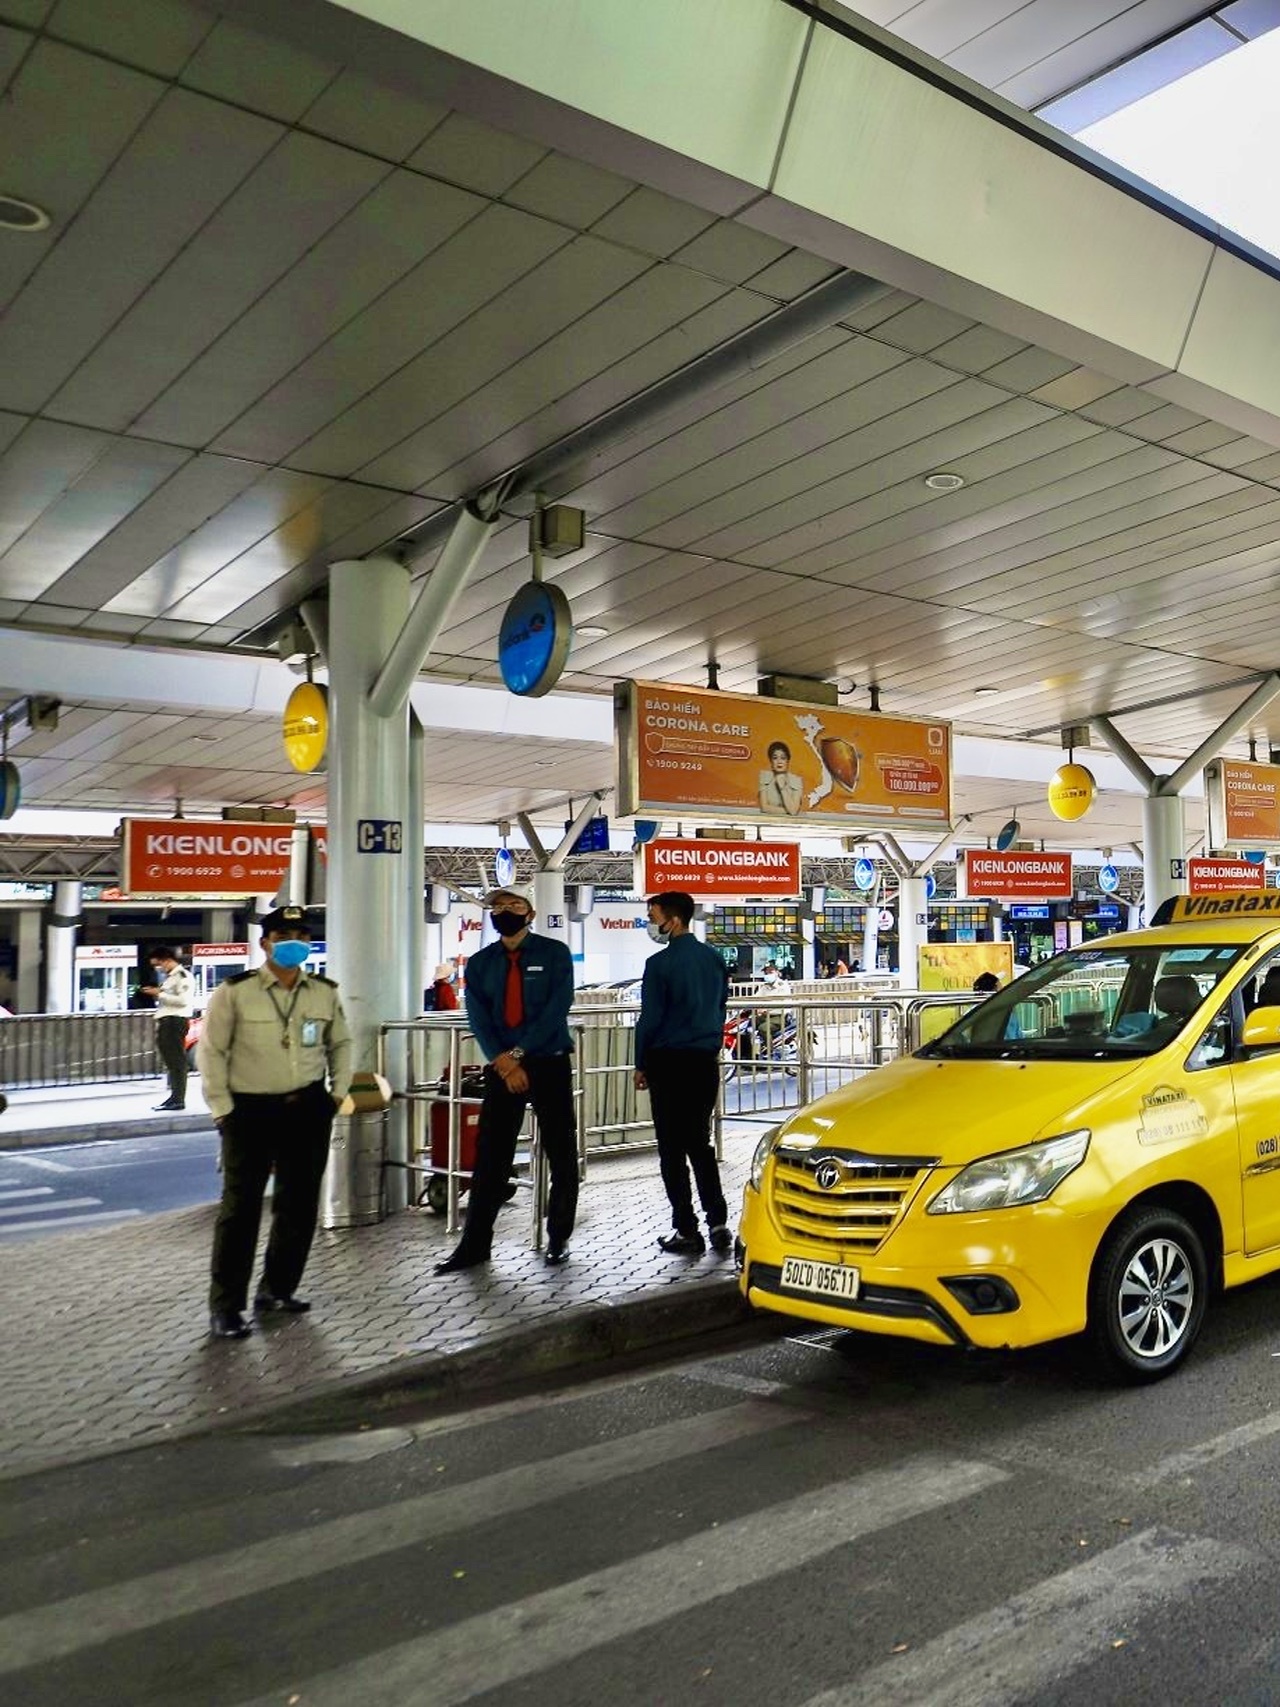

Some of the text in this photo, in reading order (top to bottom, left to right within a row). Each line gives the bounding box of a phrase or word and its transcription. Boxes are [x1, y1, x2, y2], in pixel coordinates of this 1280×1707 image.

[646, 714, 750, 737] CORONA CARE
[656, 759, 679, 770] 1900
[359, 822, 401, 851] C-13
[654, 849, 790, 867] KIENLONGBANK
[972, 860, 1065, 875] KIENLONGBANK
[1193, 866, 1261, 880] KIENLONGBANK
[1146, 1092, 1185, 1106] VINATAXI
[1256, 1139, 1278, 1158] (028)
[817, 1267, 855, 1295] 056.11
